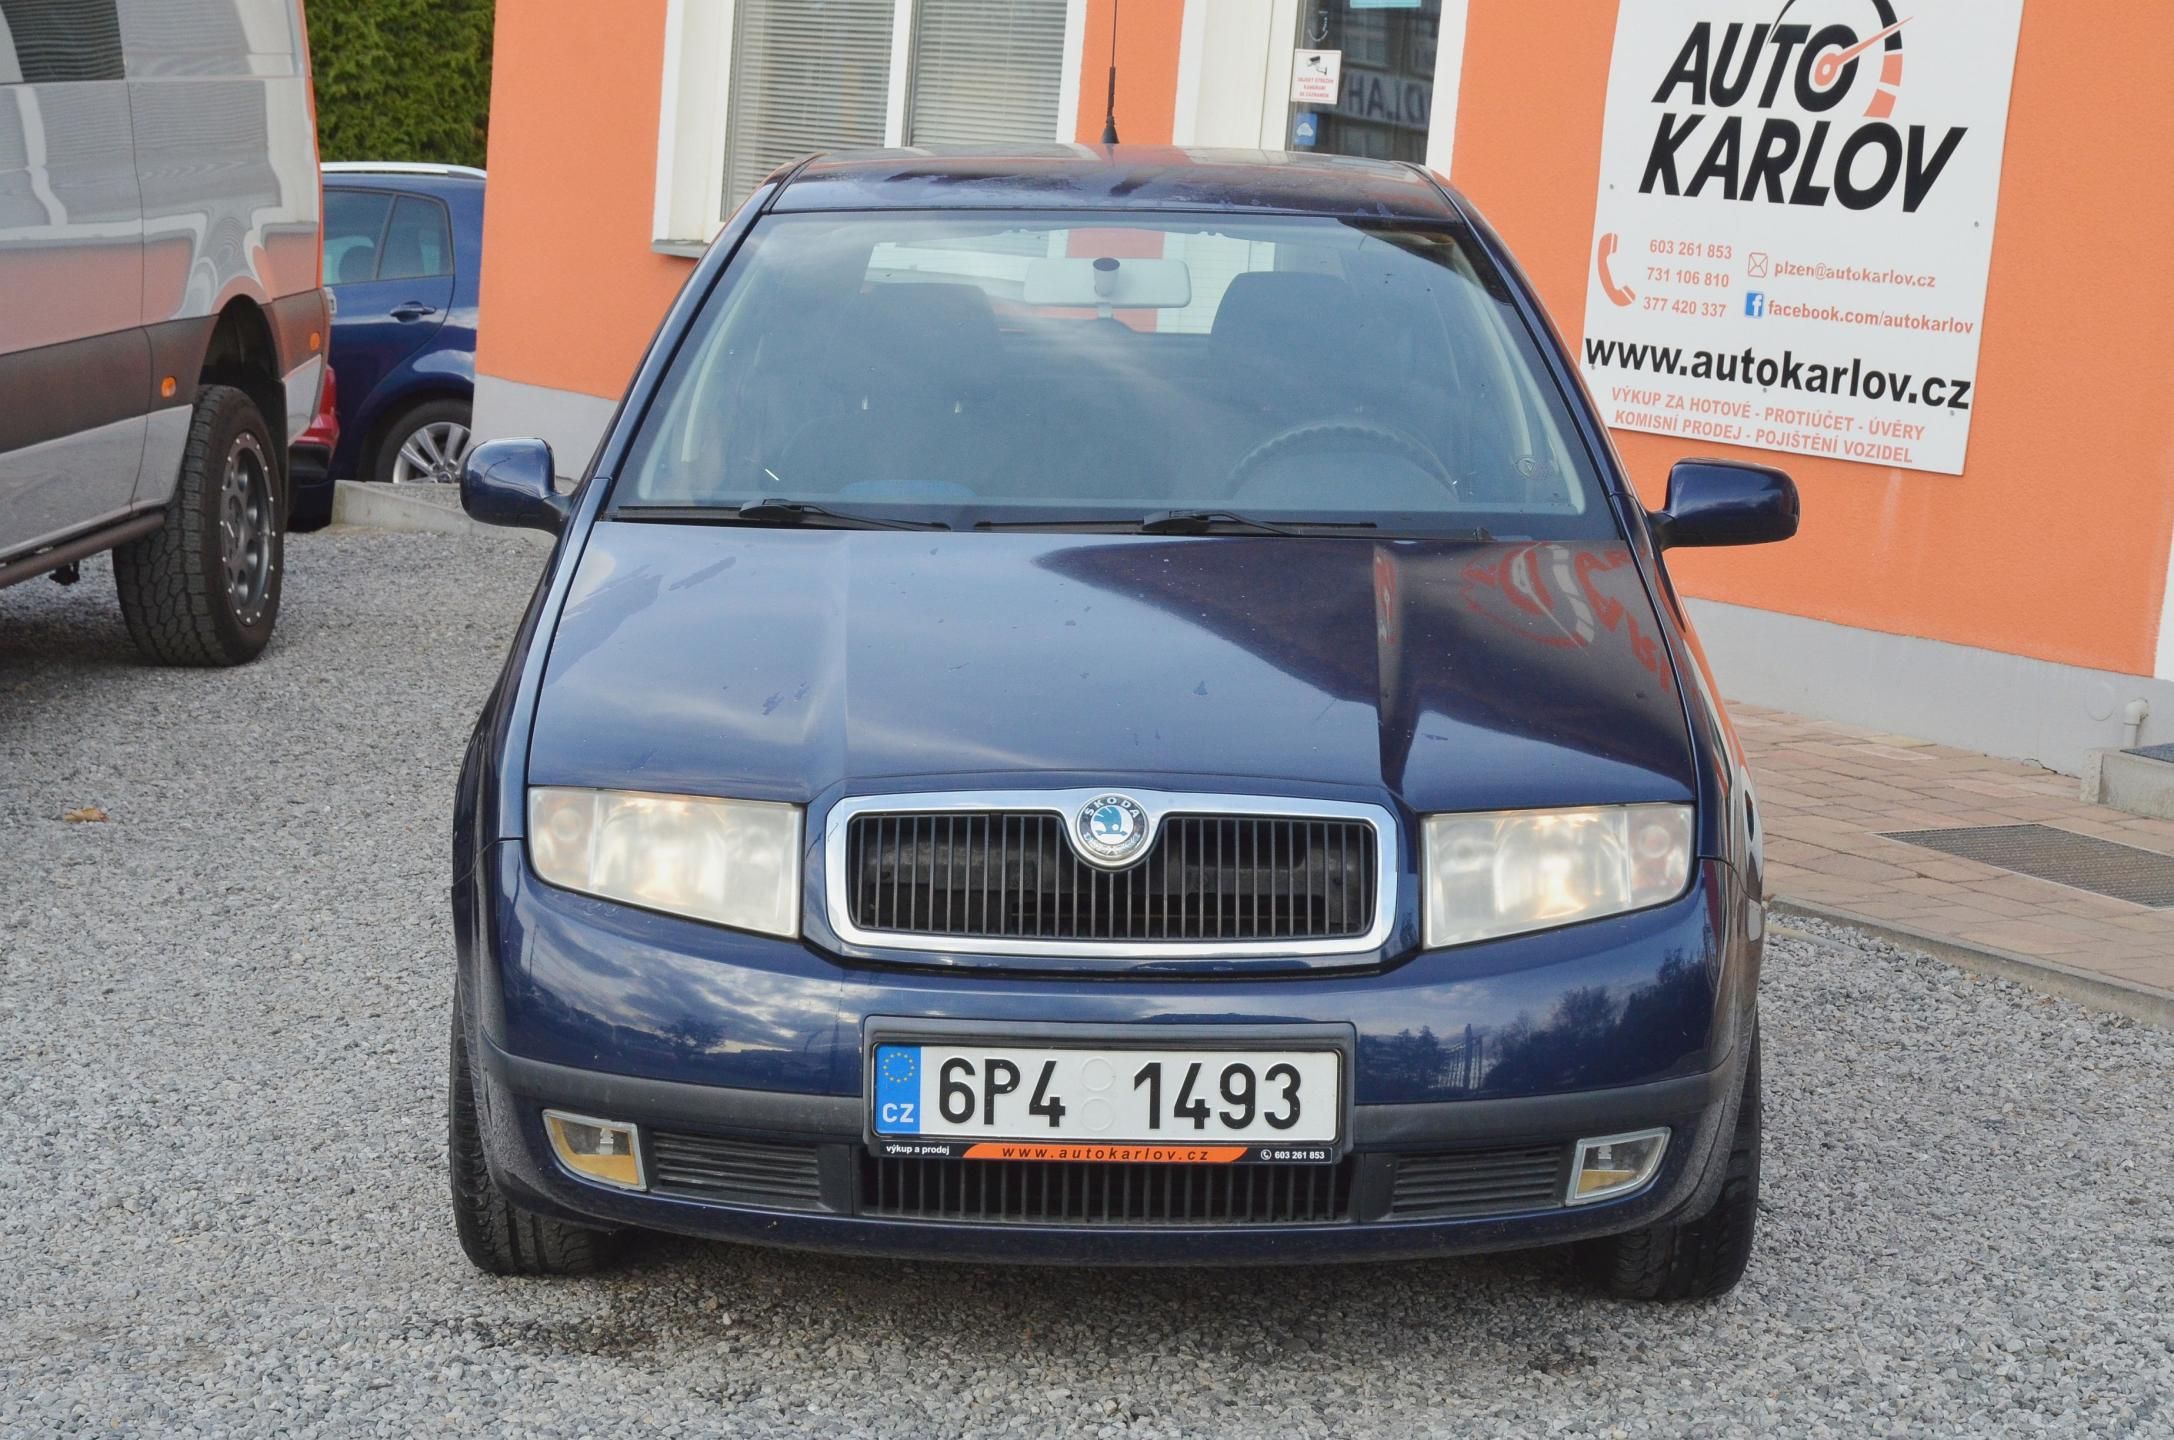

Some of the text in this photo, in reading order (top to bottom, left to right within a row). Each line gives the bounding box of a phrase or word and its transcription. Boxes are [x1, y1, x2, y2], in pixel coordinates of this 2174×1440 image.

[1651, 21, 1859, 112] AUTO
[1638, 112, 1968, 213] KARLOV
[1649, 239, 1732, 260] 603 261 853
[1647, 266, 1729, 288] 731 106 810
[1774, 260, 1936, 289] plzen@autokarlov.cz
[1643, 296, 1727, 318] 377 420 337
[1768, 300, 1974, 334] facebook.com/autokarlov
[1585, 337, 1971, 410] www.autokarlov.cz
[1611, 385, 1662, 406] VÝKUP
[1664, 394, 1685, 410] ZA
[1689, 397, 1751, 419] HOTOVÉ
[1764, 407, 1854, 432] PROTIÚČET
[1868, 416, 1925, 441] ÚVĚRY
[1615, 409, 1679, 431] KOMISNÍ
[1682, 419, 1742, 440] PRODEJ
[1755, 428, 1838, 453] POJIŠTĚNÍ
[1844, 439, 1913, 463] VOZIDEL
[938, 1056, 1302, 1131] 6P4 1493
[882, 1102, 914, 1123] CZ
[886, 1144, 912, 1155] výkup
[921, 1145, 950, 1156] prodej
[1002, 1145, 1209, 1161] www.autokarlov.cz
[1274, 1151, 1325, 1160] 603 261 853
